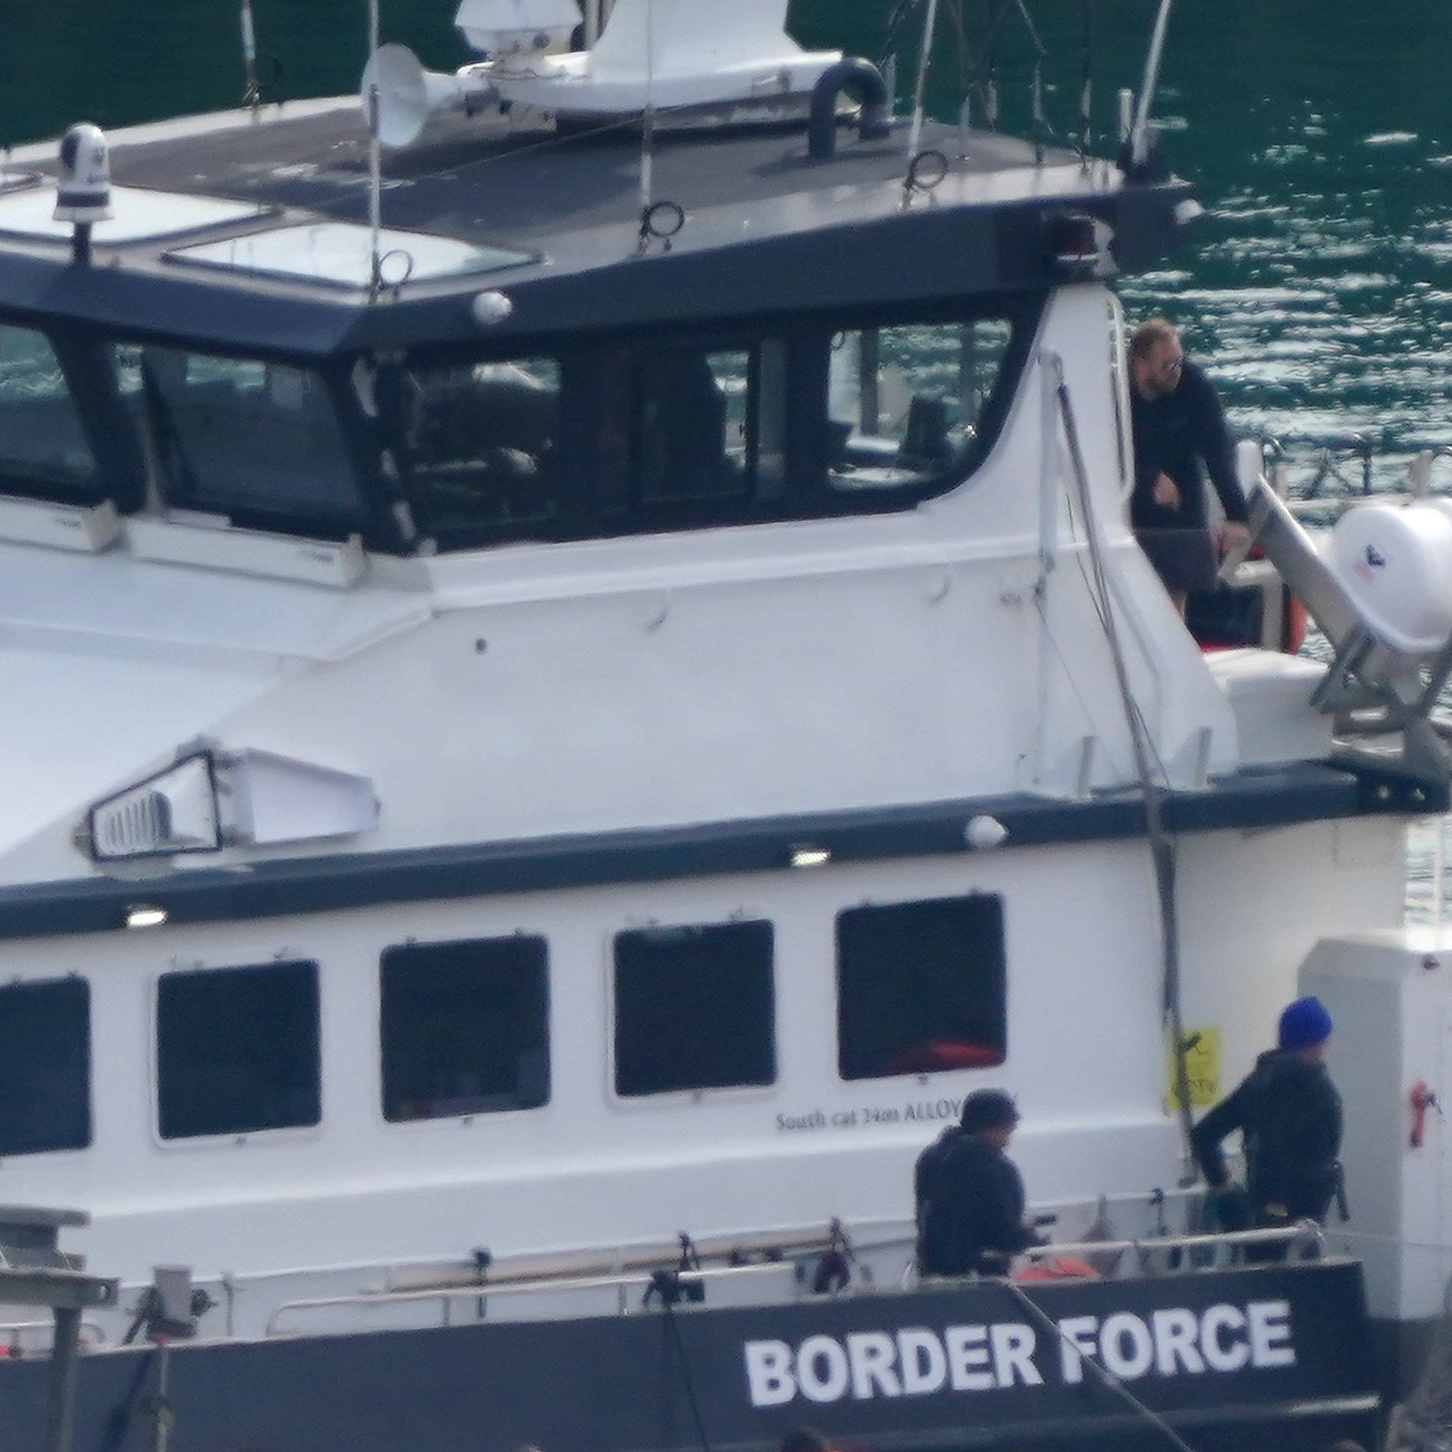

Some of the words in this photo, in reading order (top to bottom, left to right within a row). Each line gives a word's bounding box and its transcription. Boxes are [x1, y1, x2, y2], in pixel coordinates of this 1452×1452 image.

[905, 1098, 963, 1121] ALLOY
[744, 1322, 1043, 1407] BORDER
[1058, 1300, 1296, 1384] FORCE
